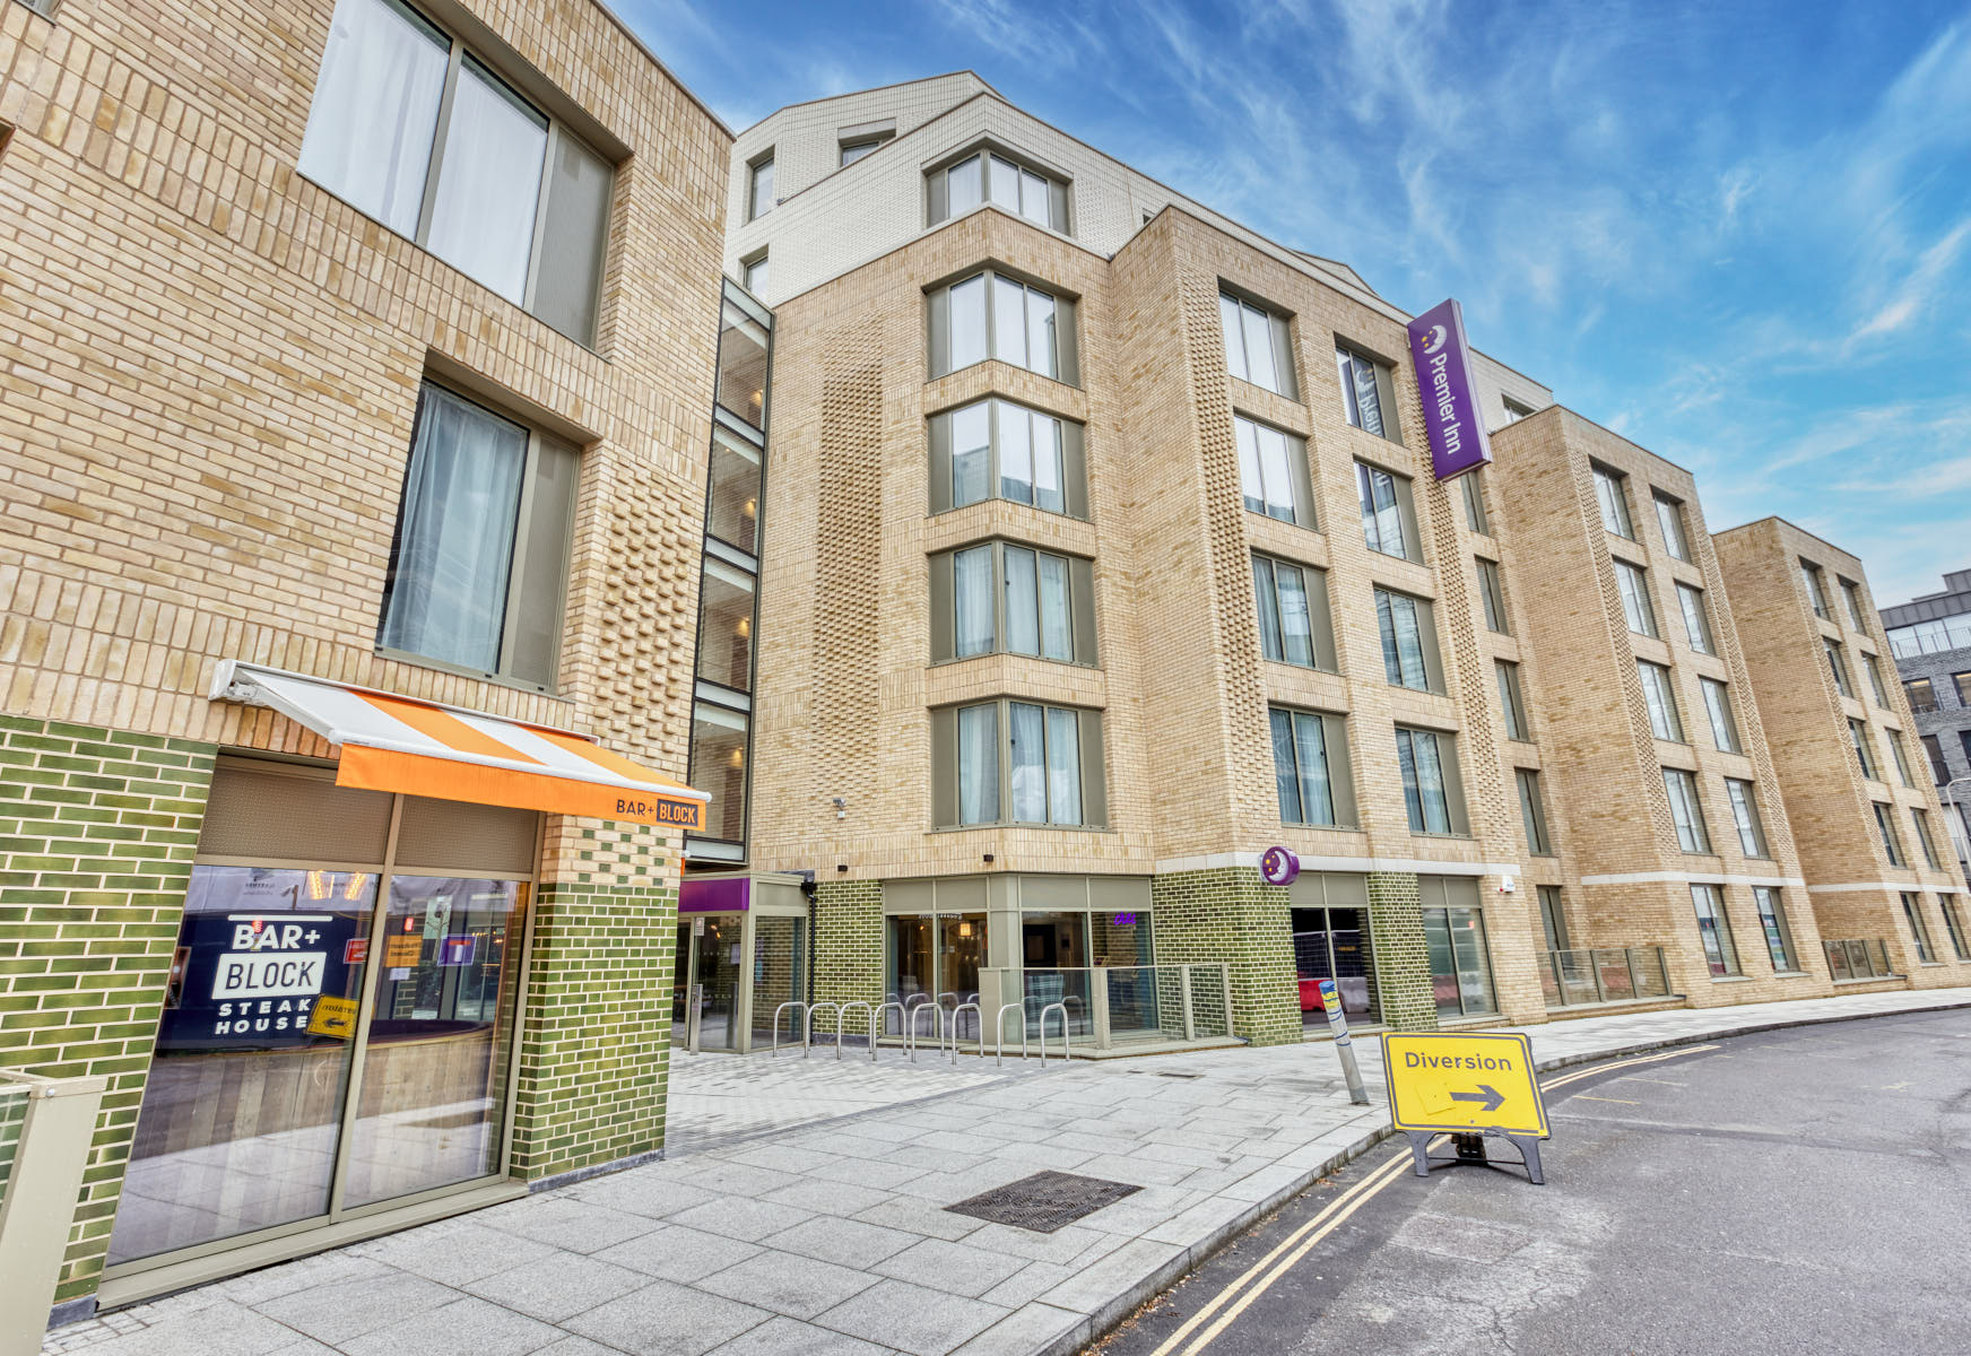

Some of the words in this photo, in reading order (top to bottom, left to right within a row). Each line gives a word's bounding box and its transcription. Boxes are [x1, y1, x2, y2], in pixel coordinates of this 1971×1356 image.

[1430, 352, 1456, 422] Premier
[1443, 422, 1462, 455] Inn
[660, 803, 696, 824] BLOCK
[232, 924, 321, 950] BAR+
[225, 961, 316, 990] BLOCK
[219, 998, 312, 1017] STEAK
[214, 1015, 308, 1035] HOUSE
[1405, 1052, 1512, 1071] Diversion
